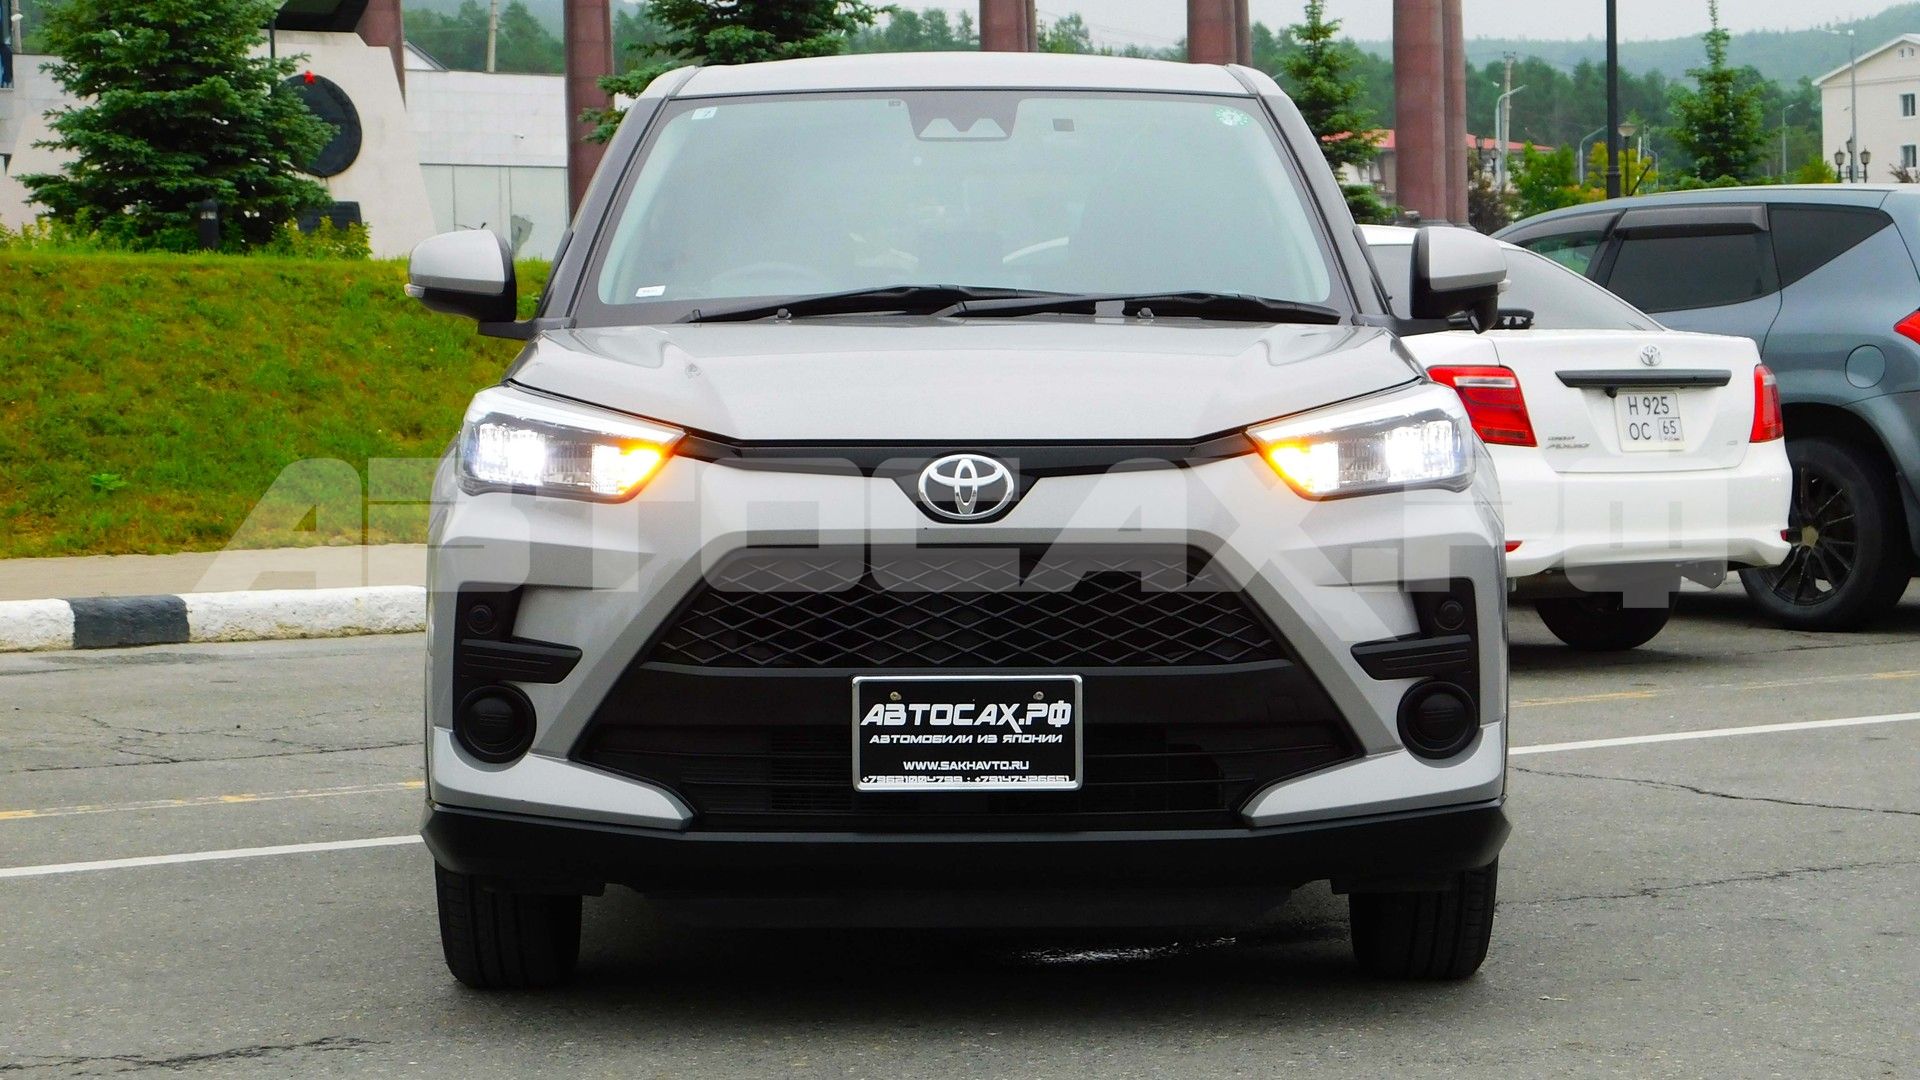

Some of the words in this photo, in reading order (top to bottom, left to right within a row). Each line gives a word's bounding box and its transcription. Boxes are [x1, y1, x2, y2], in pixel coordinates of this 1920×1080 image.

[1627, 395, 1639, 416] Н
[1643, 395, 1670, 415] 925
[1629, 422, 1652, 441] ОС
[1662, 420, 1677, 435] 65
[860, 700, 1072, 733] АВТОСАХ.РФ
[869, 734, 974, 744] АВТОМОБИЛИ
[977, 734, 998, 744] ИЗ
[1002, 734, 1063, 744] ЯПОНИИ
[902, 760, 1030, 770] WWW.SAKHAVTO.RU
